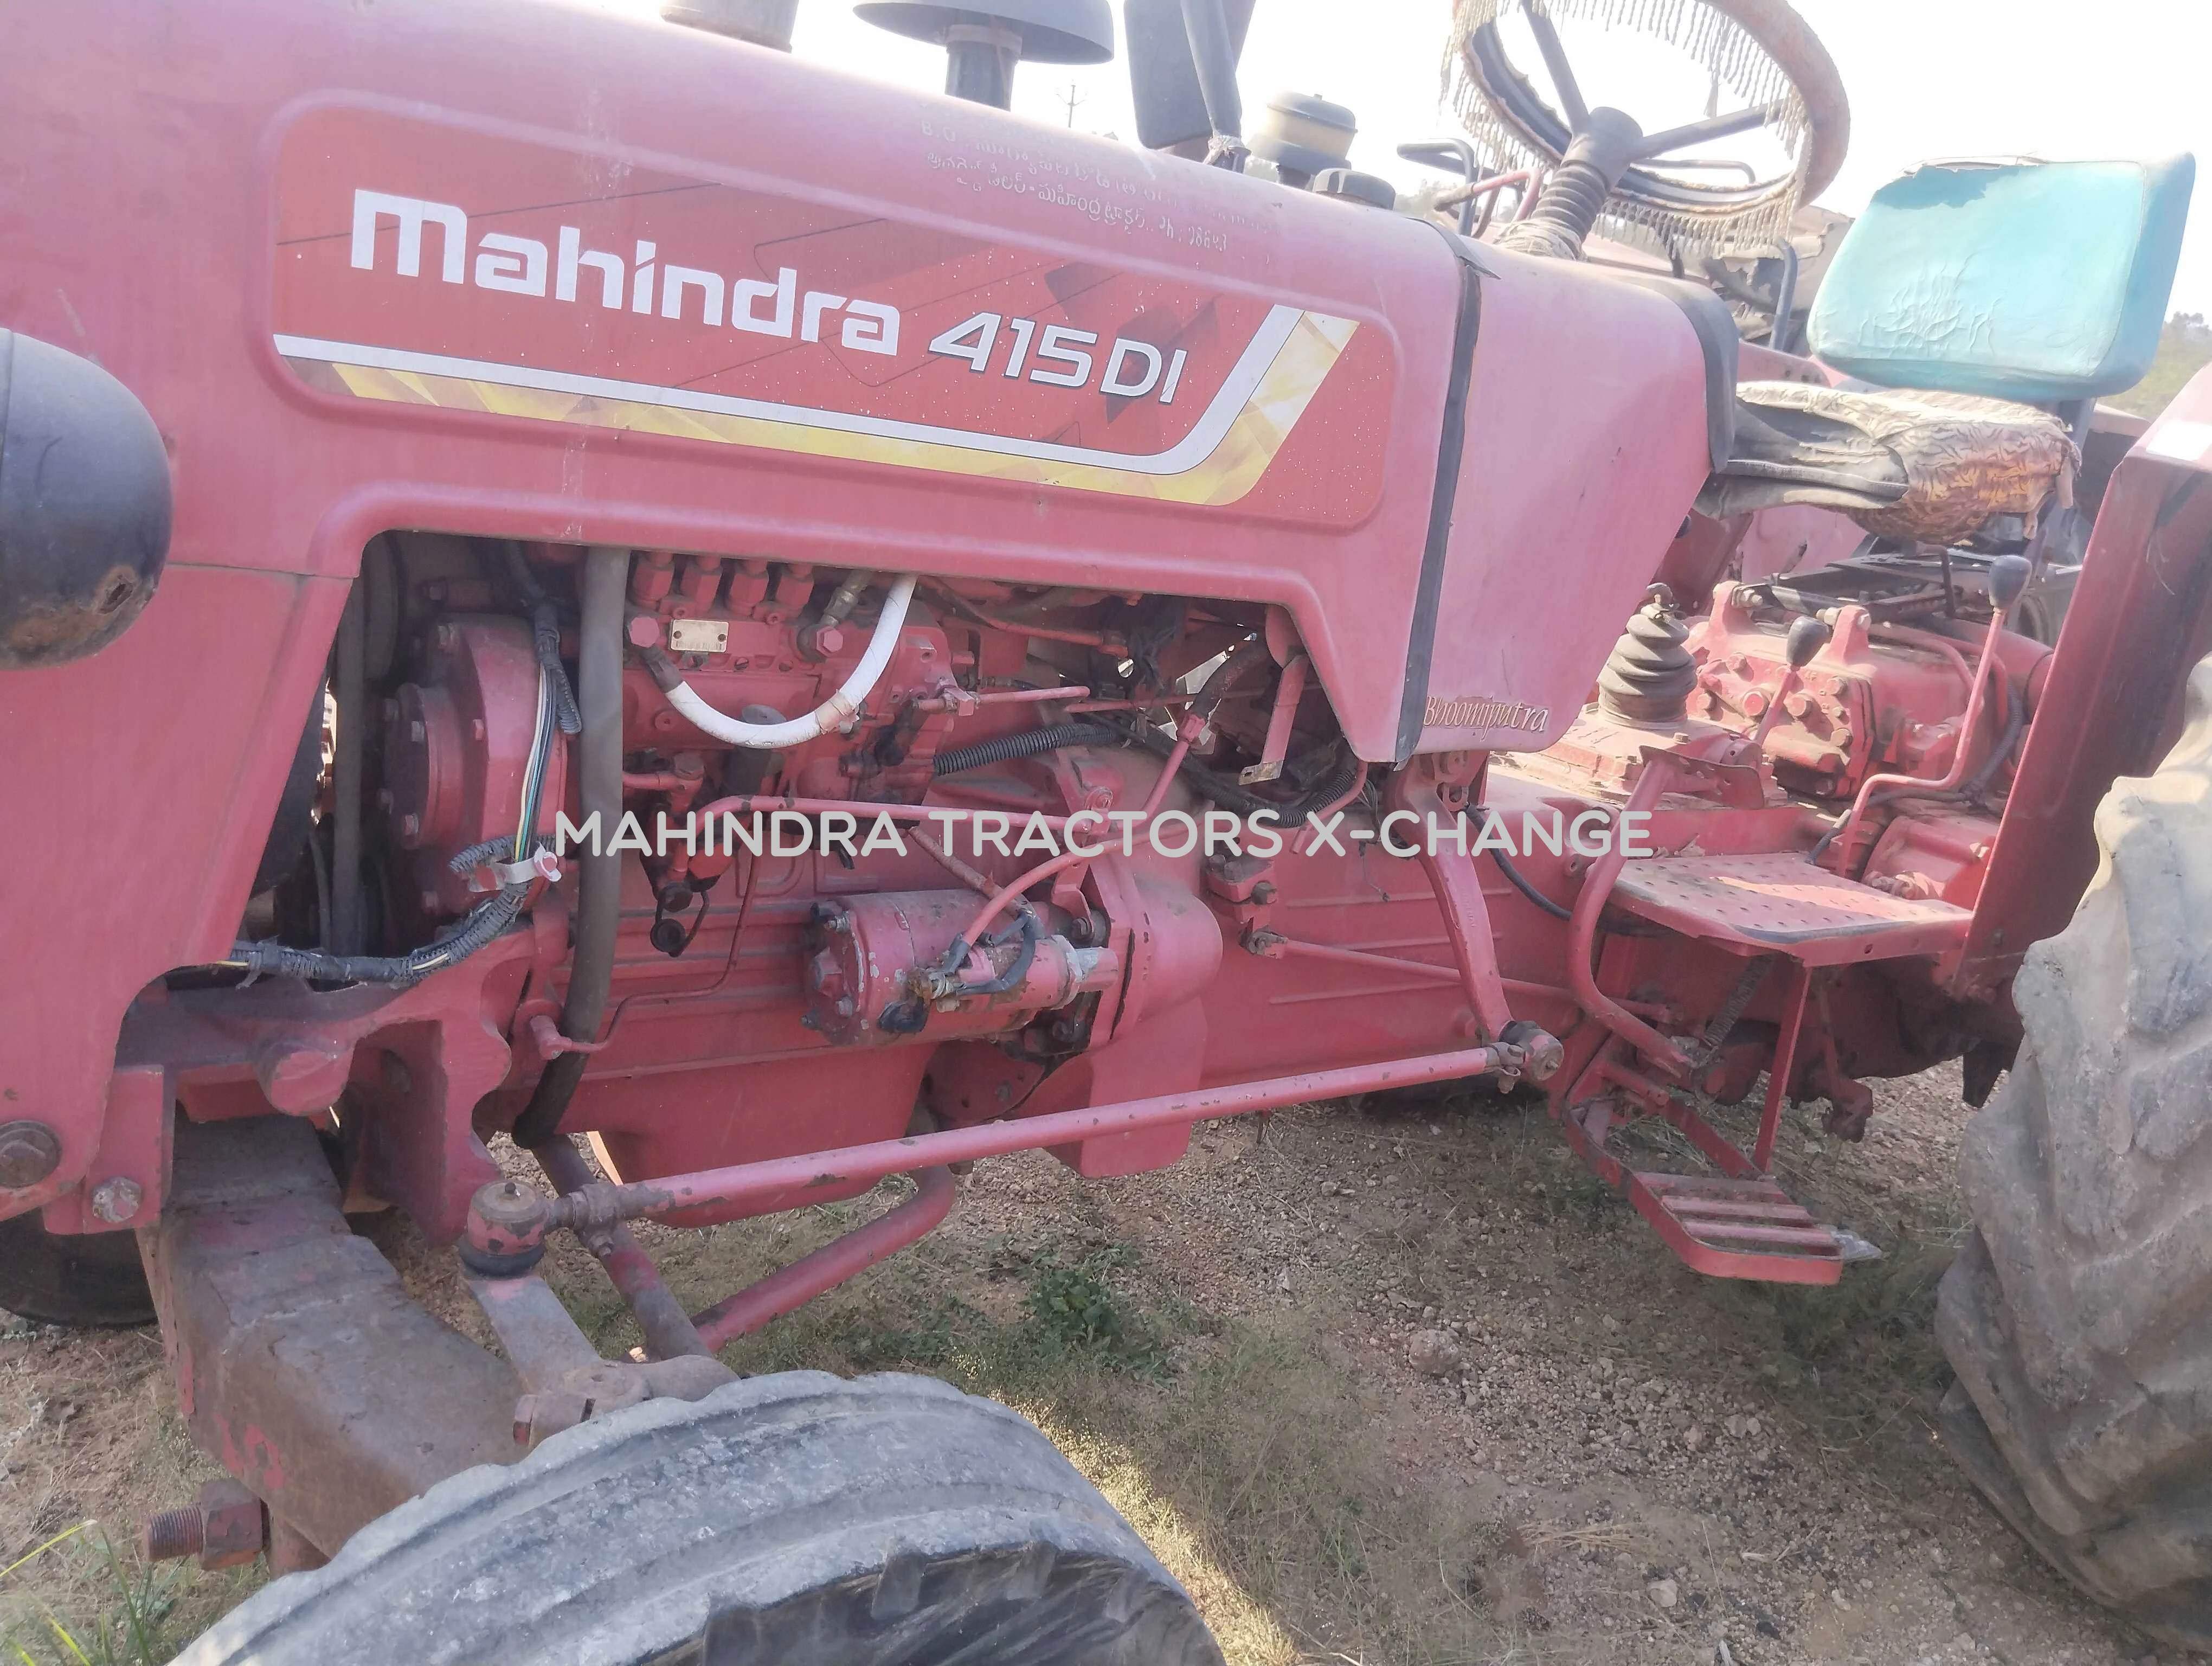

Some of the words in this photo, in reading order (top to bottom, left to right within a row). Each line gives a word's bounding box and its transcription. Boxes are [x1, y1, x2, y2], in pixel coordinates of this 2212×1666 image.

[929, 311, 1098, 390] 415
[1099, 336, 1189, 405] DI
[1423, 695, 1549, 742] Bhoomiputra
